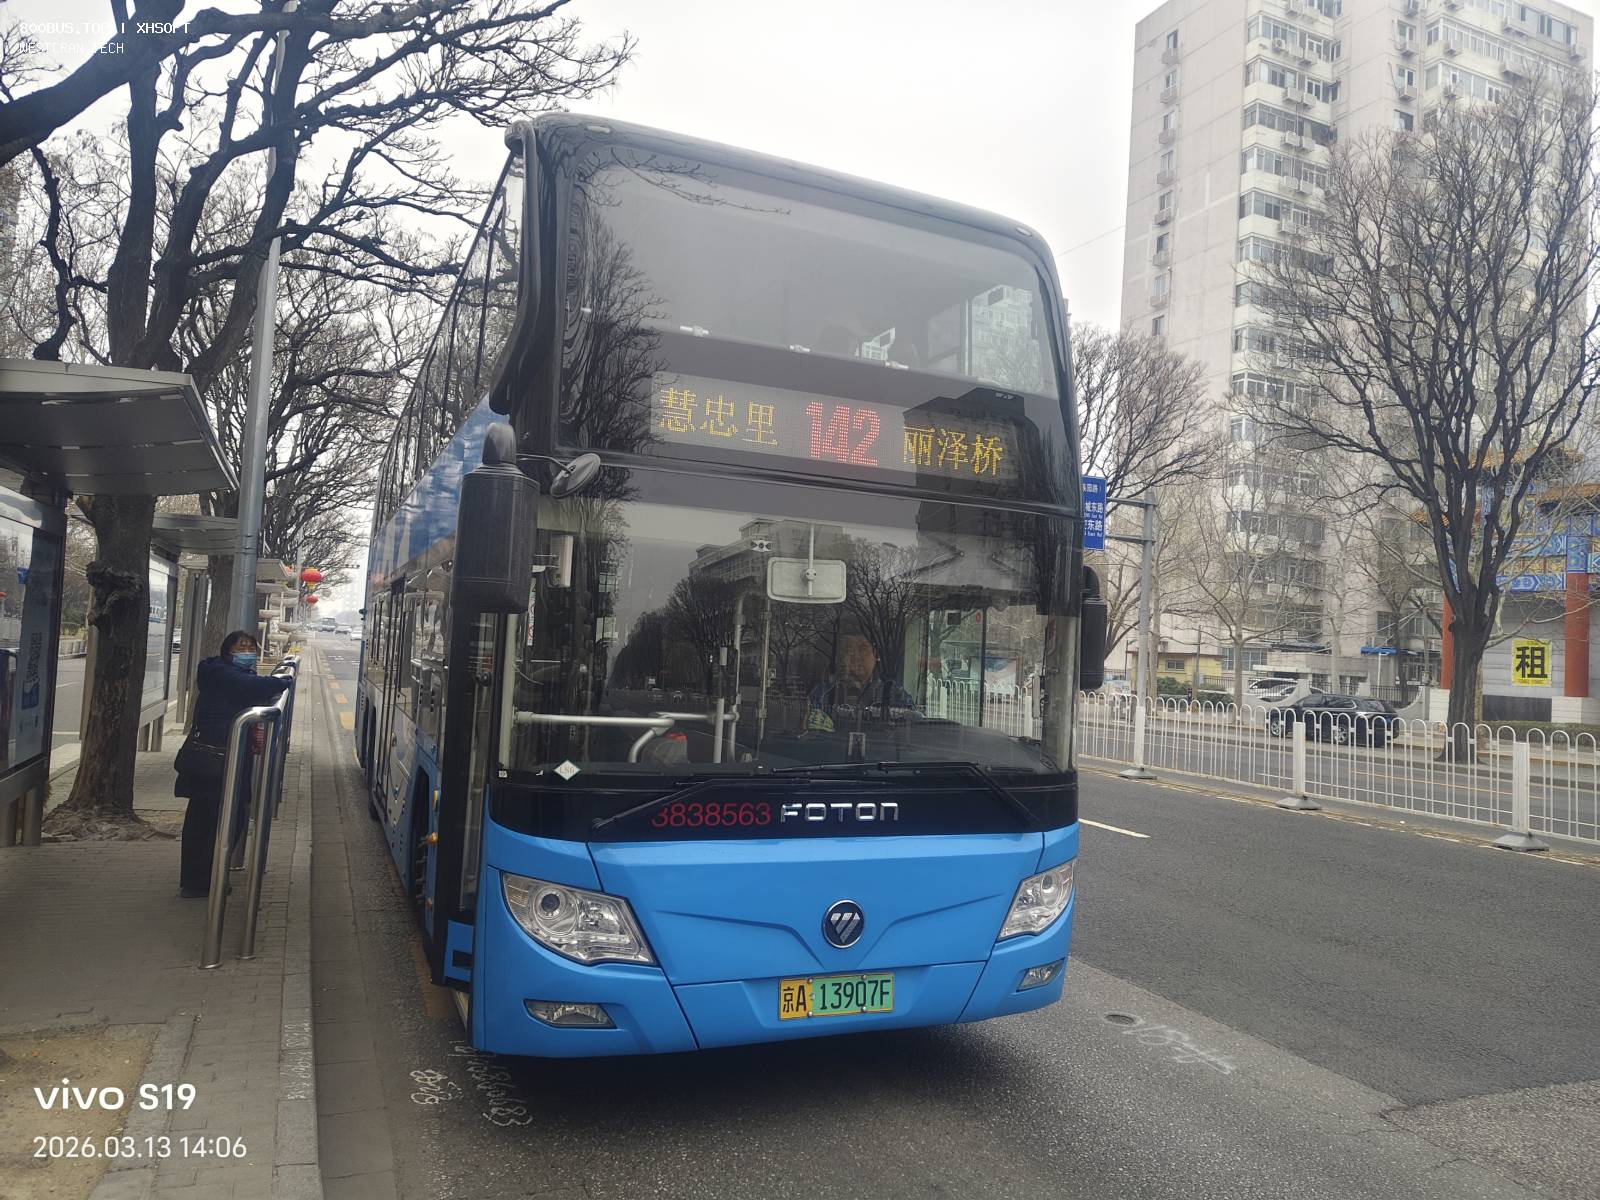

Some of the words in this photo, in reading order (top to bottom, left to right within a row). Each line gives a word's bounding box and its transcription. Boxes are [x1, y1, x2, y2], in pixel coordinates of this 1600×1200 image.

[659, 387, 777, 447] 慧忠里
[805, 400, 881, 468] 142
[902, 424, 1004, 477] 丽泽桥
[1516, 646, 1548, 679] 租
[652, 801, 772, 828] 3838563
[780, 802, 900, 822] FOTON
